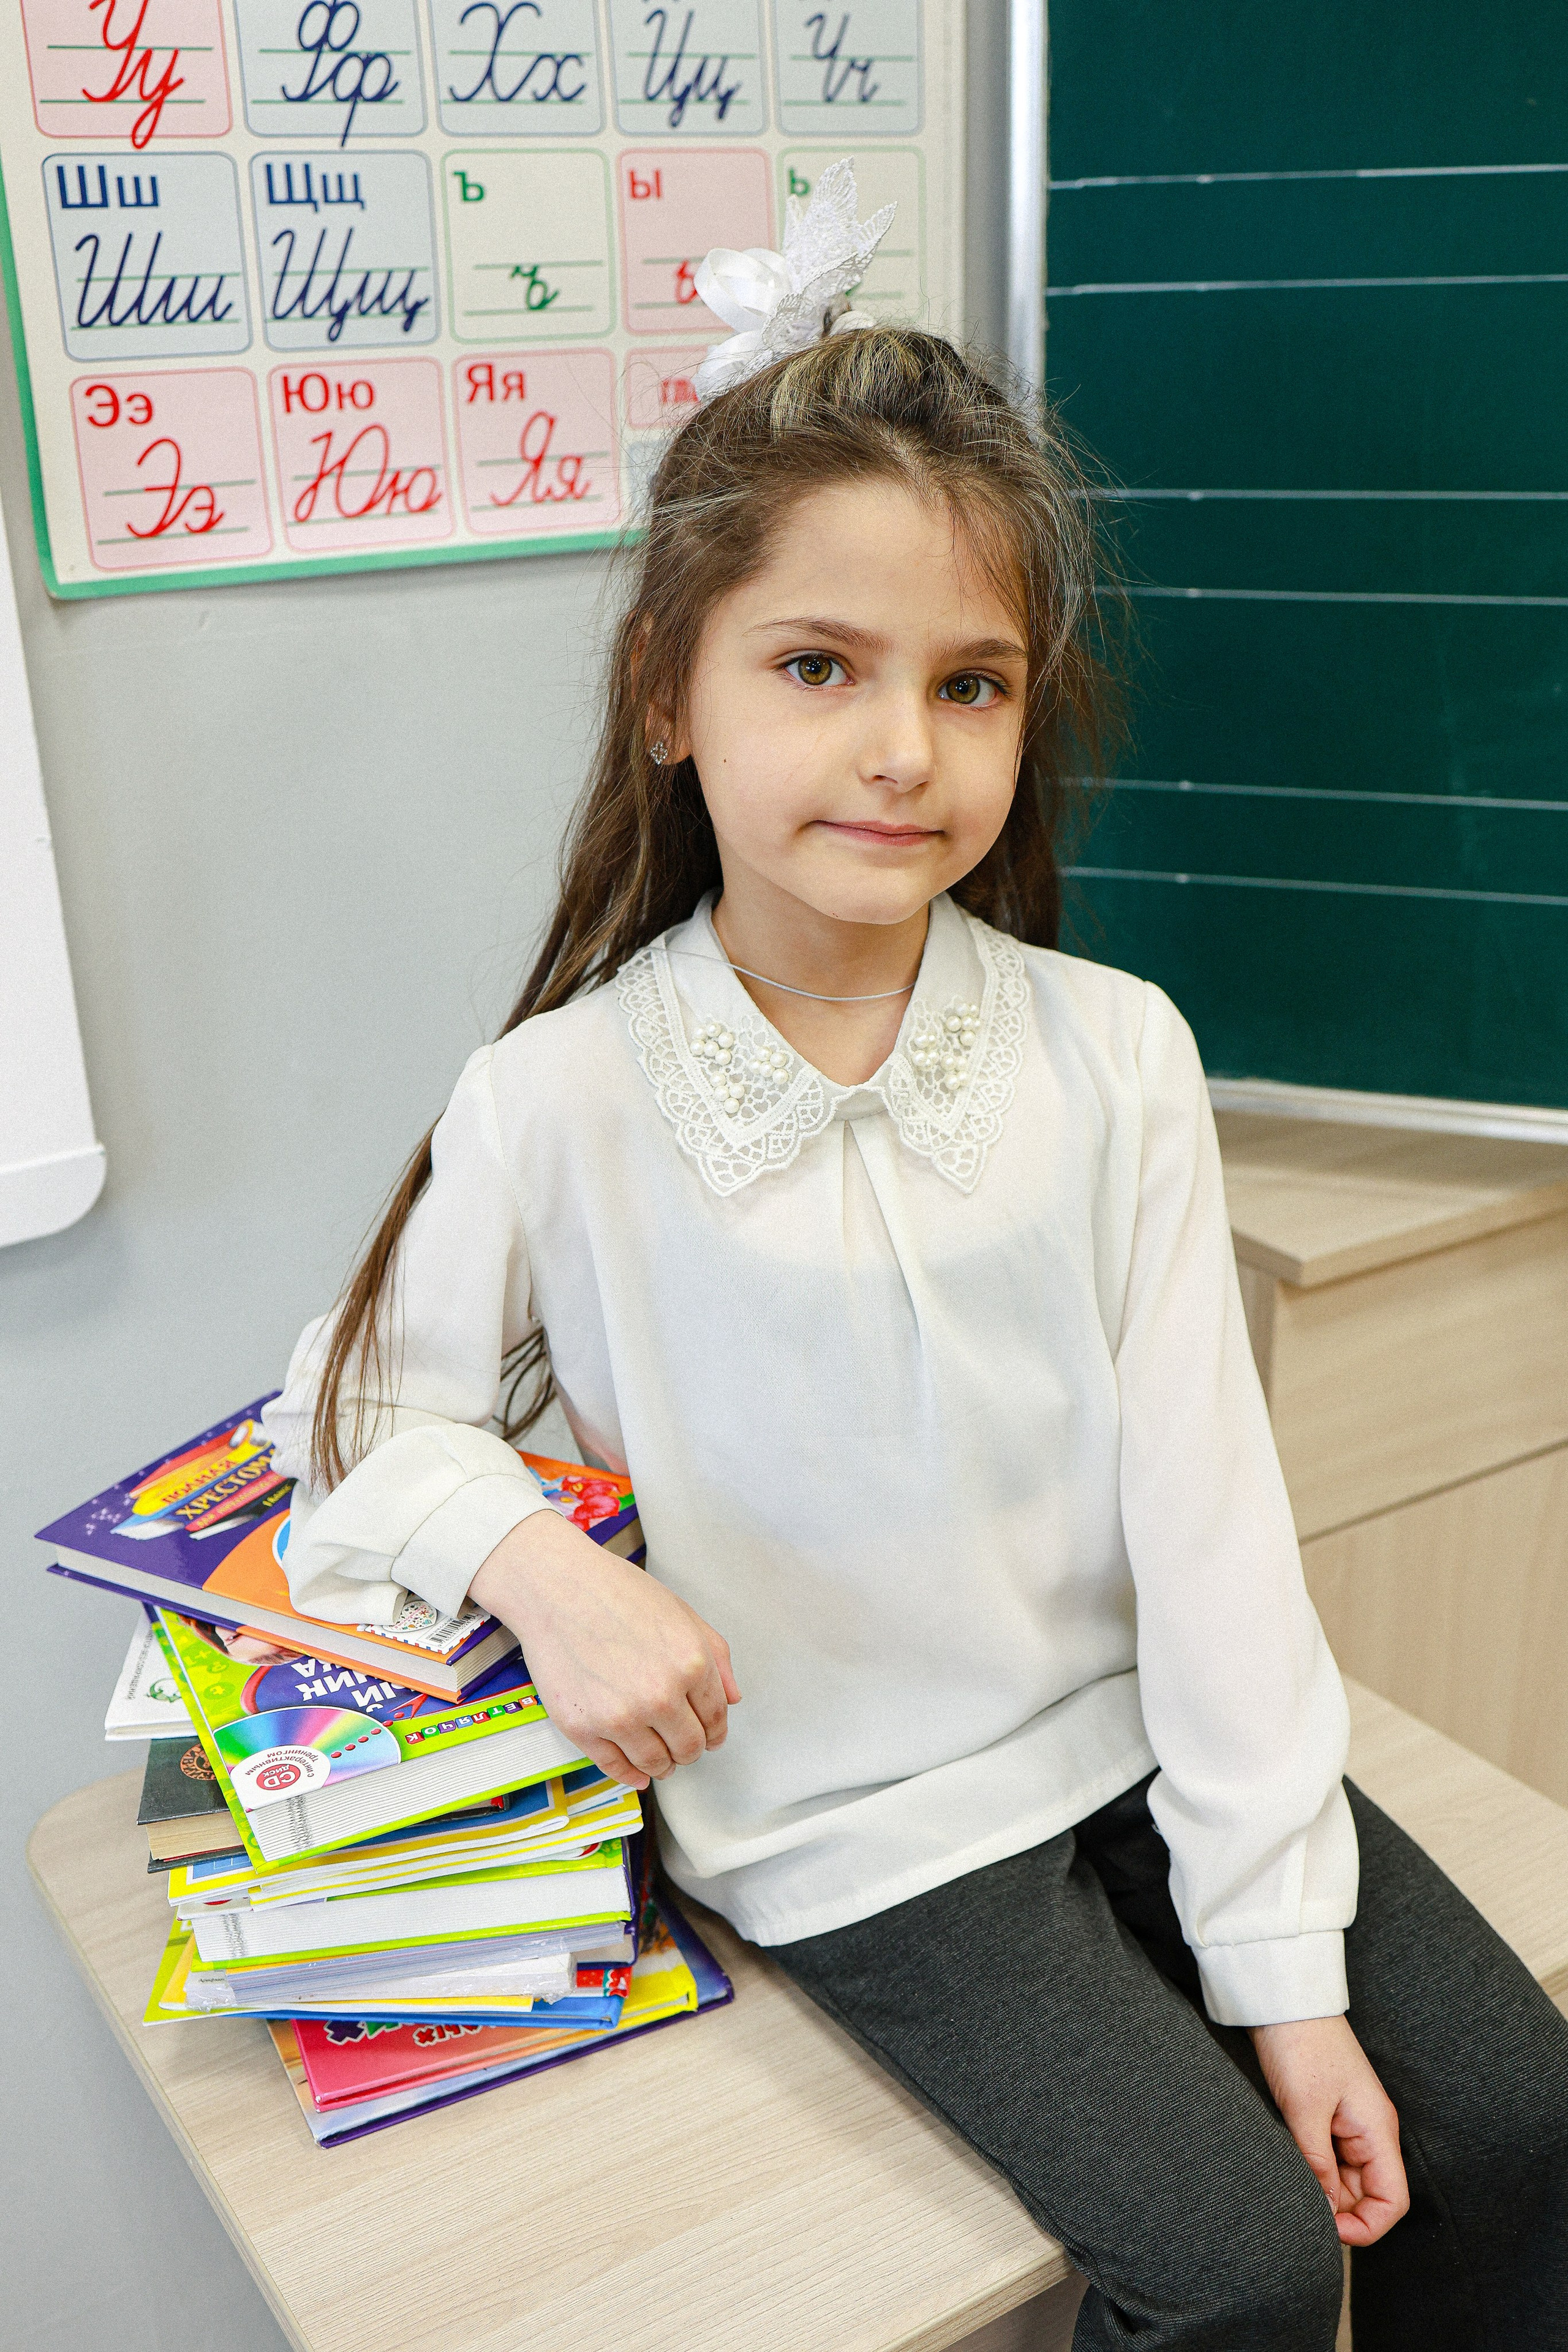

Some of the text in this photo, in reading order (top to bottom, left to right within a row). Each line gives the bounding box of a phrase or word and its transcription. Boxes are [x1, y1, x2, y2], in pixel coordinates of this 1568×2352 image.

[445, 2, 586, 103] Хх
[645, 10, 740, 127] Цц
[807, 13, 878, 102] Чч
[56, 165, 159, 209] Шш
[266, 164, 365, 212] Щщ
[75, 232, 233, 328] Шш
[273, 228, 430, 342] Щщ
[85, 384, 154, 428] Ээ
[282, 372, 375, 414] Юю
[466, 363, 526, 404] Яя
[126, 437, 225, 539] Ээ
[293, 424, 443, 523] Юю
[491, 411, 591, 507] Яя
[175, 1448, 276, 1520] ХРЕСТОМ
[408, 1695, 541, 1743] ВЕТЛЯЧОК
[245, 1755, 314, 1776] интерактивным
[263, 1770, 296, 1789] CD
[267, 1749, 319, 1763] тренингом
